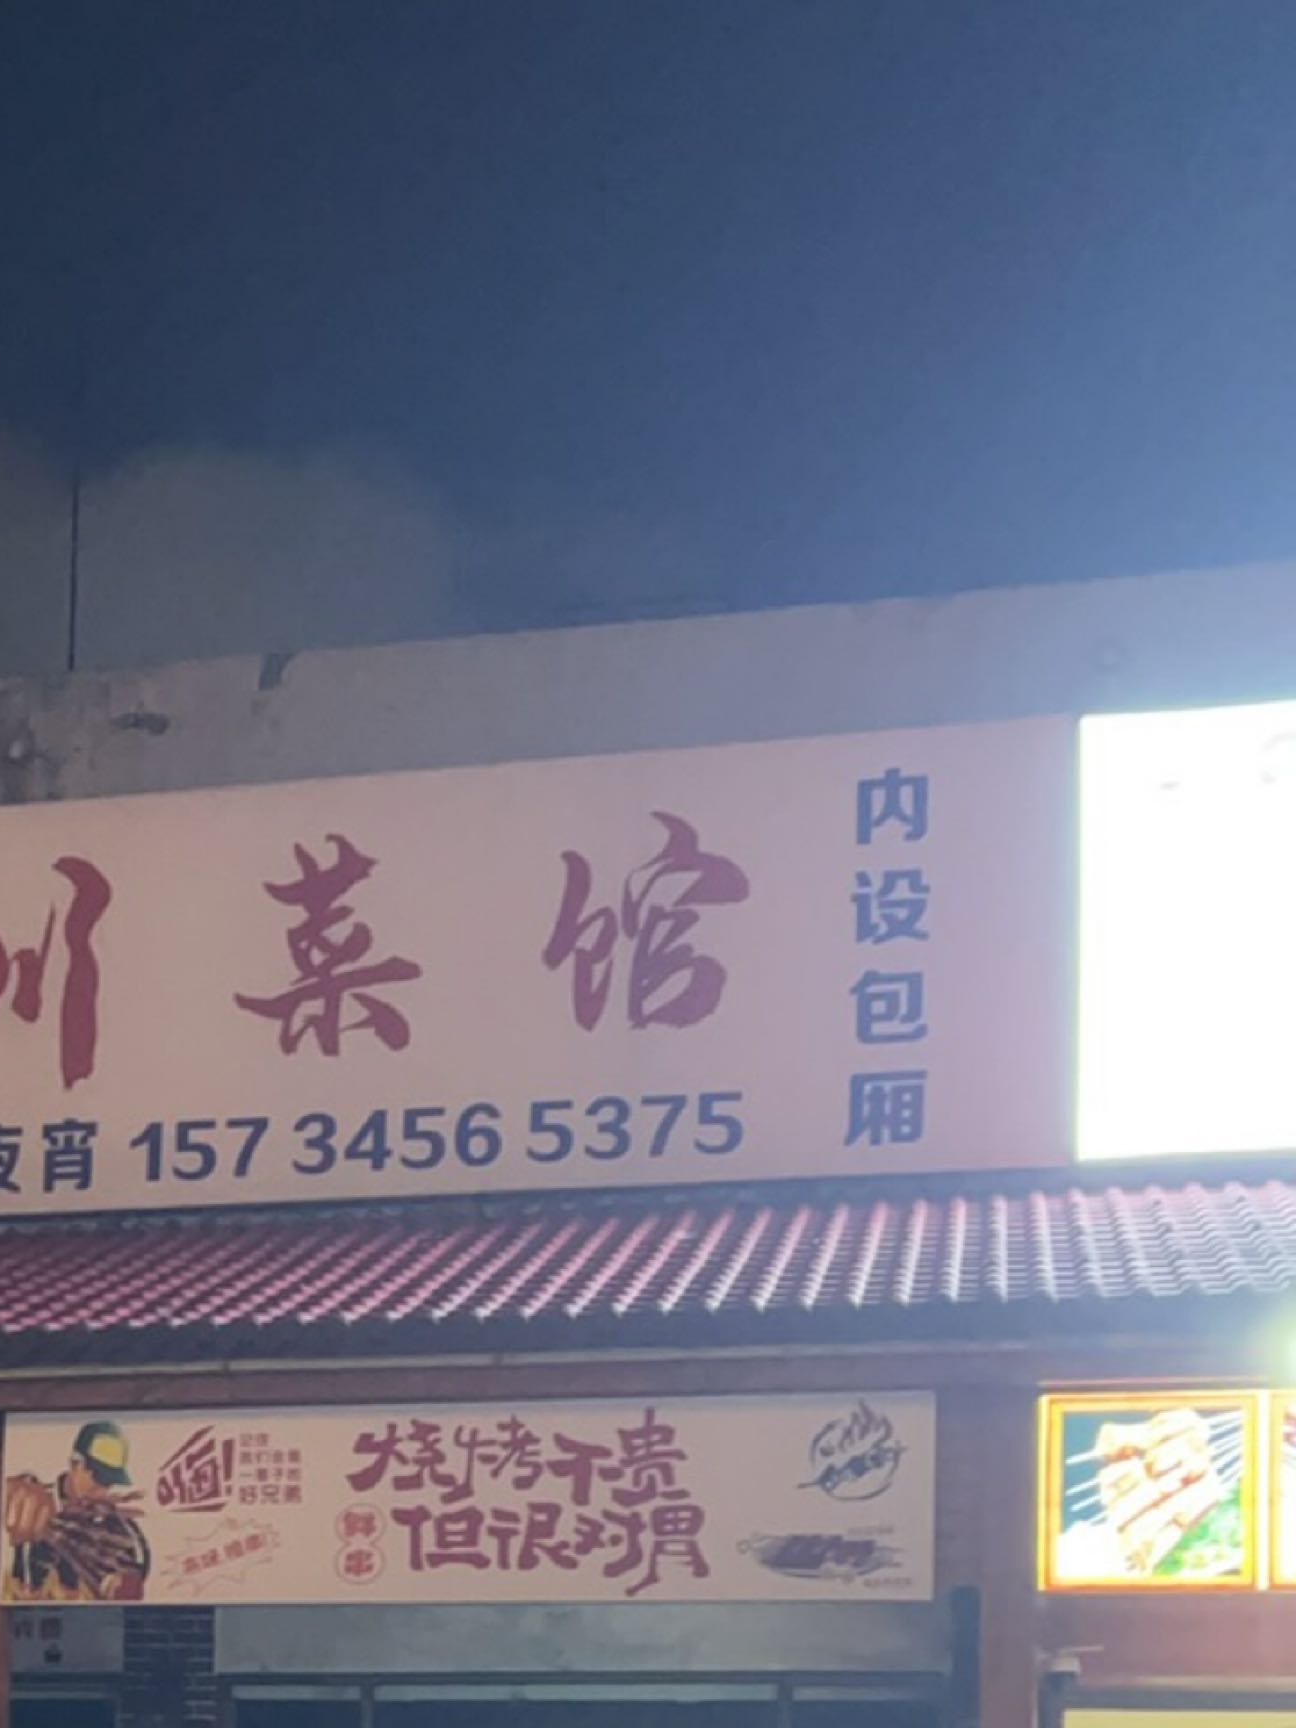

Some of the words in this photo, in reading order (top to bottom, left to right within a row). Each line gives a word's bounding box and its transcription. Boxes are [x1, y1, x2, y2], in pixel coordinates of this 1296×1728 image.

[843, 766, 930, 1147] 内设包厢
[129, 1116, 271, 1182] 157
[291, 1102, 503, 1175] 3456
[527, 1091, 744, 1162] 5375
[346, 1407, 689, 1506] 烧烤不贵
